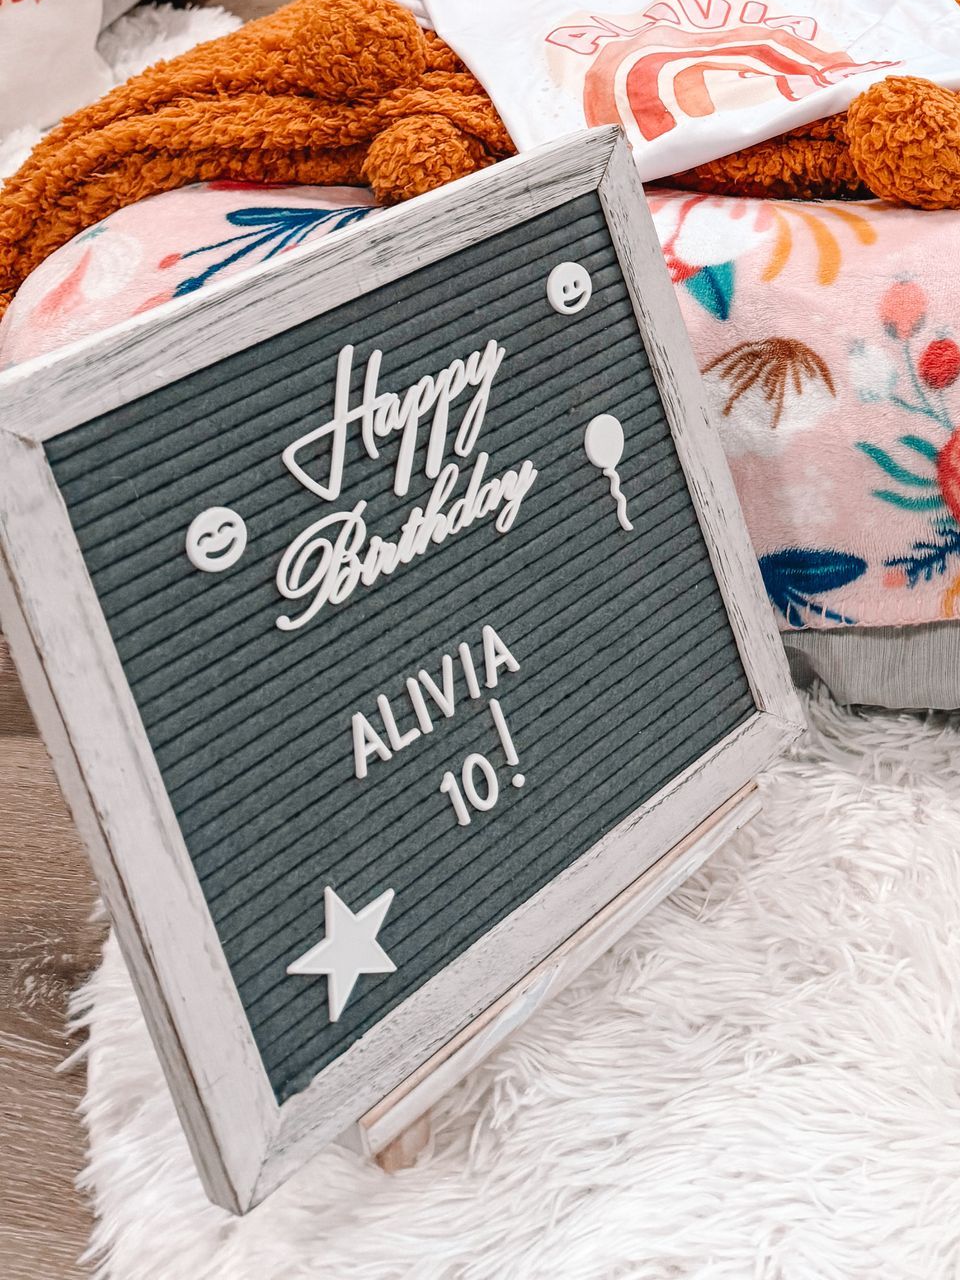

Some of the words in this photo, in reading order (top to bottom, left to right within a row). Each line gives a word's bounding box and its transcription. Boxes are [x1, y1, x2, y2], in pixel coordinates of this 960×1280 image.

[282, 339, 506, 502] Happy
[276, 452, 538, 631] Birthday
[352, 625, 520, 779] ALIVIA
[440, 698, 526, 825] 10!
